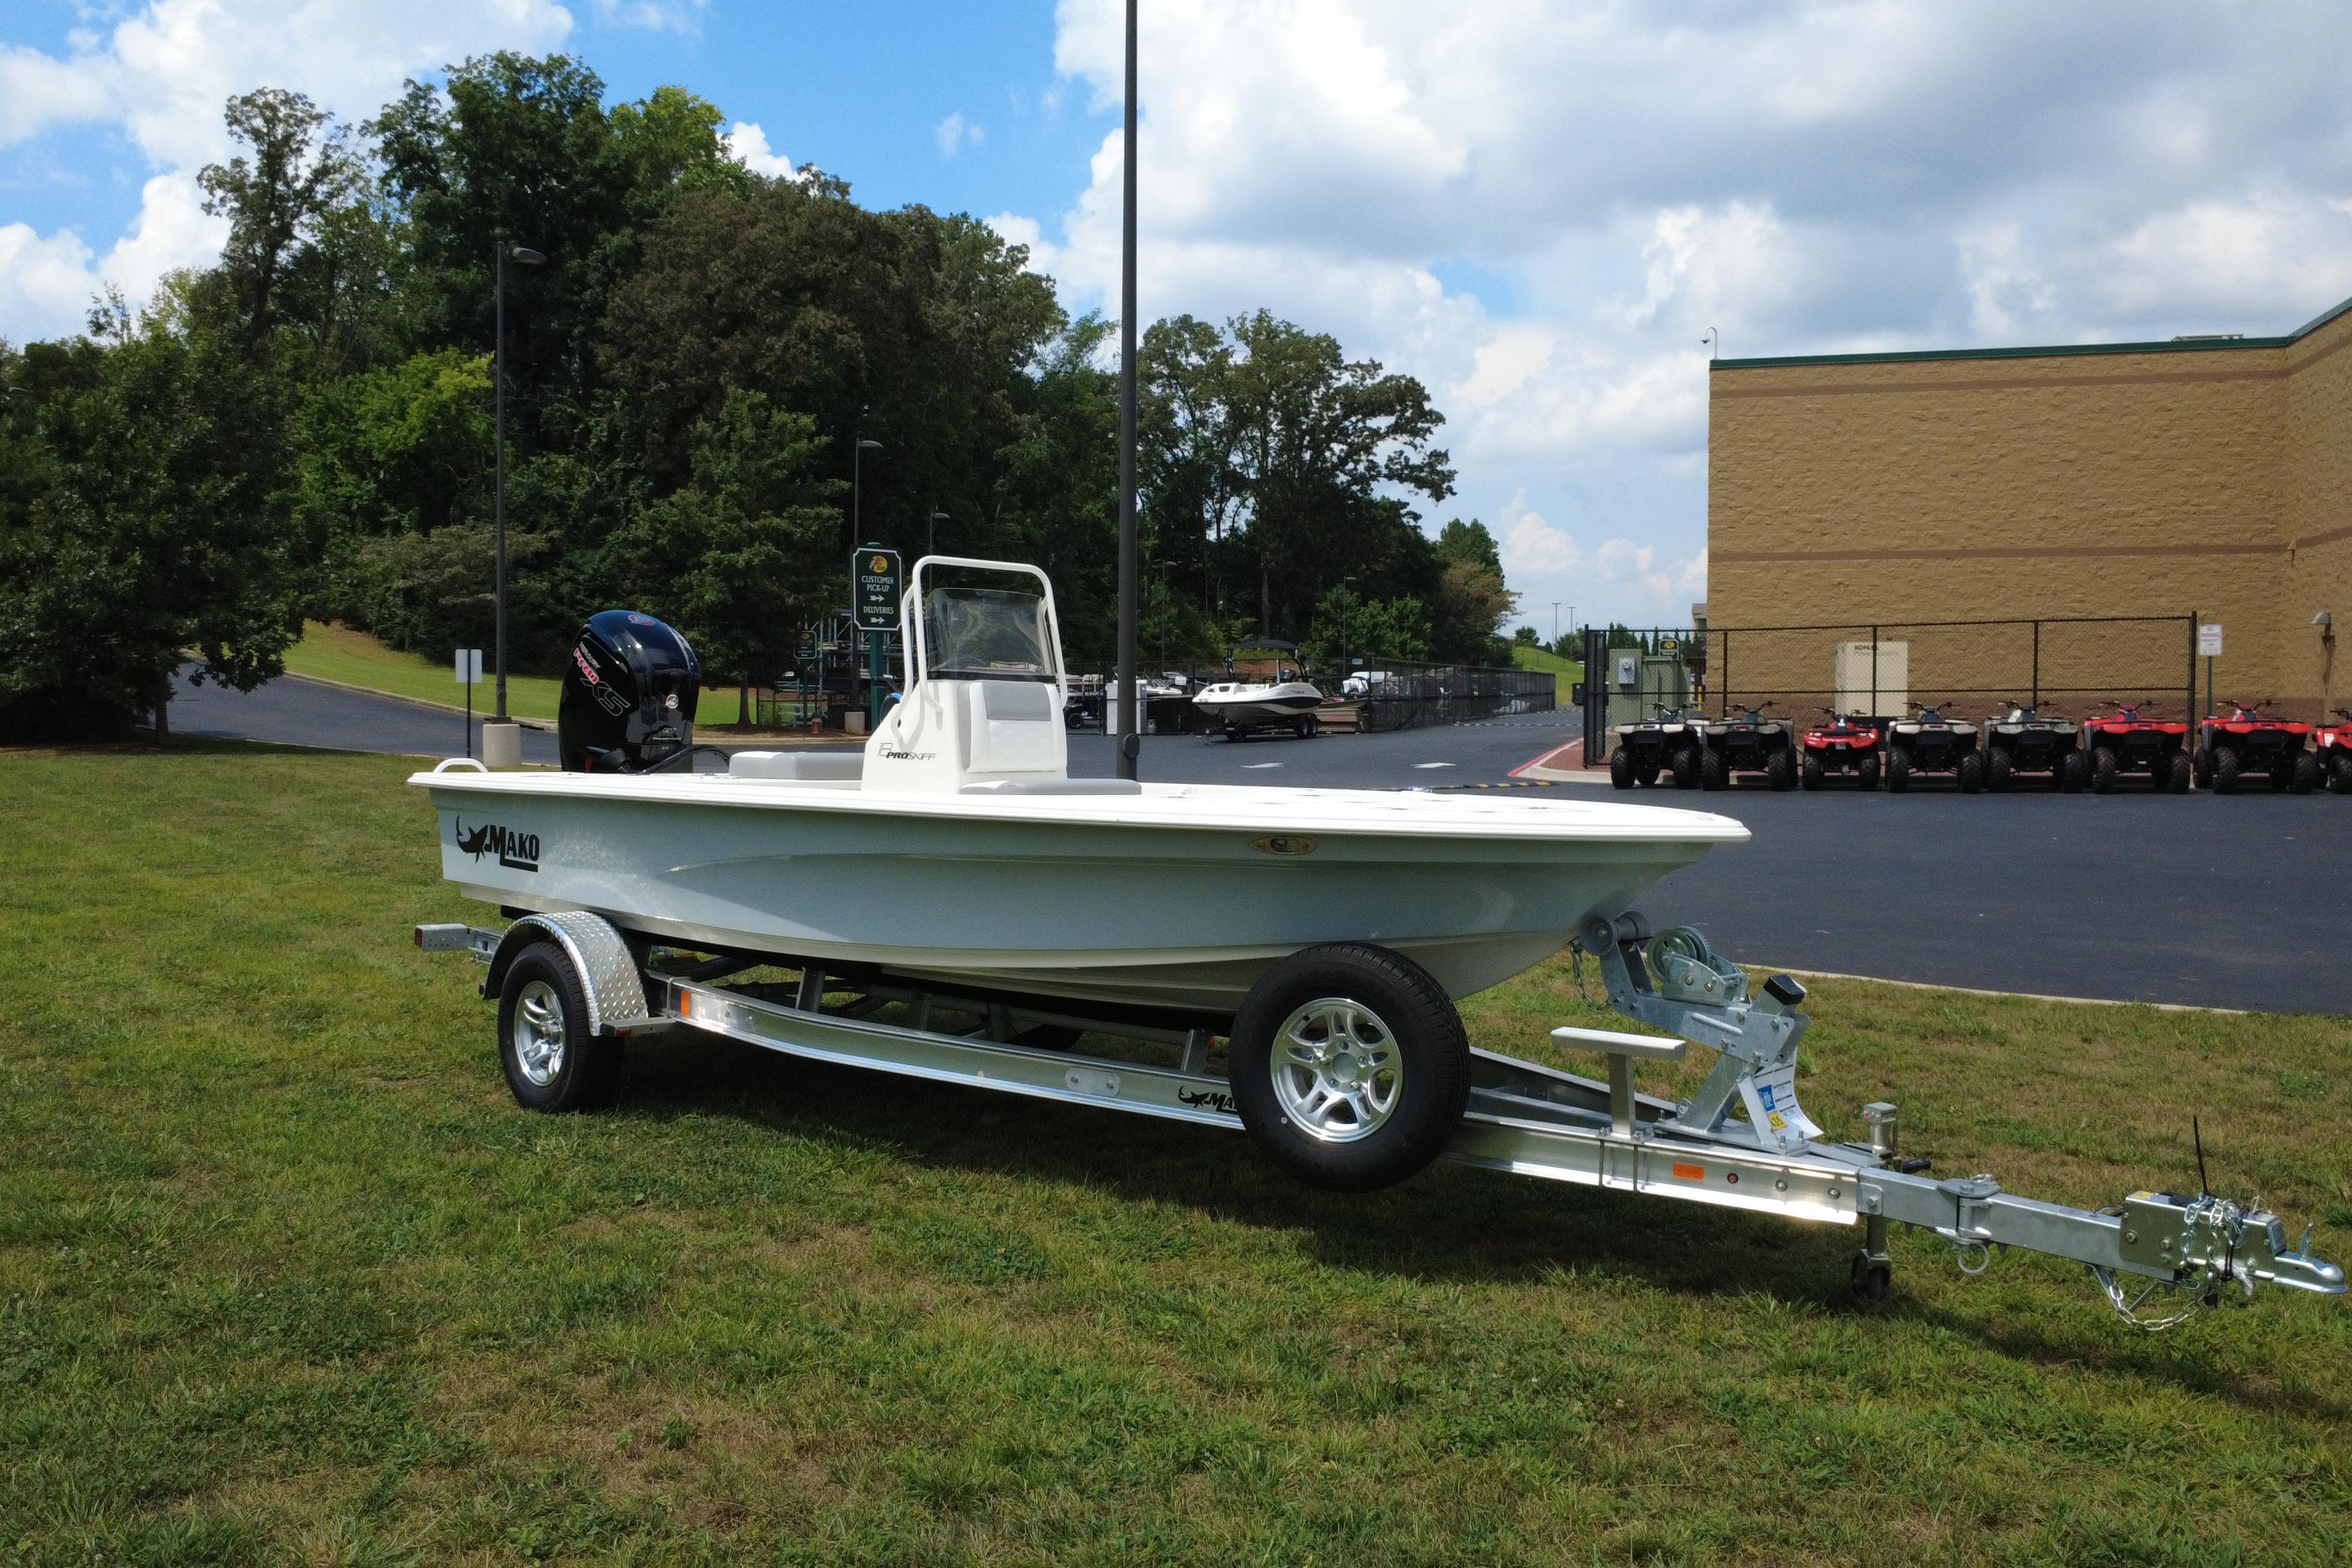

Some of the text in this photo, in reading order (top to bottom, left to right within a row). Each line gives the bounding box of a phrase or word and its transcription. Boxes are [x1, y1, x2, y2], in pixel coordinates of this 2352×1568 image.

[861, 575, 894, 584] CUSTOMER
[866, 584, 890, 592] PICK-UP
[863, 606, 894, 615] DELIVERIES
[579, 641, 602, 669] MERCURY
[573, 647, 599, 685] PRO
[484, 824, 540, 873] MAKO
